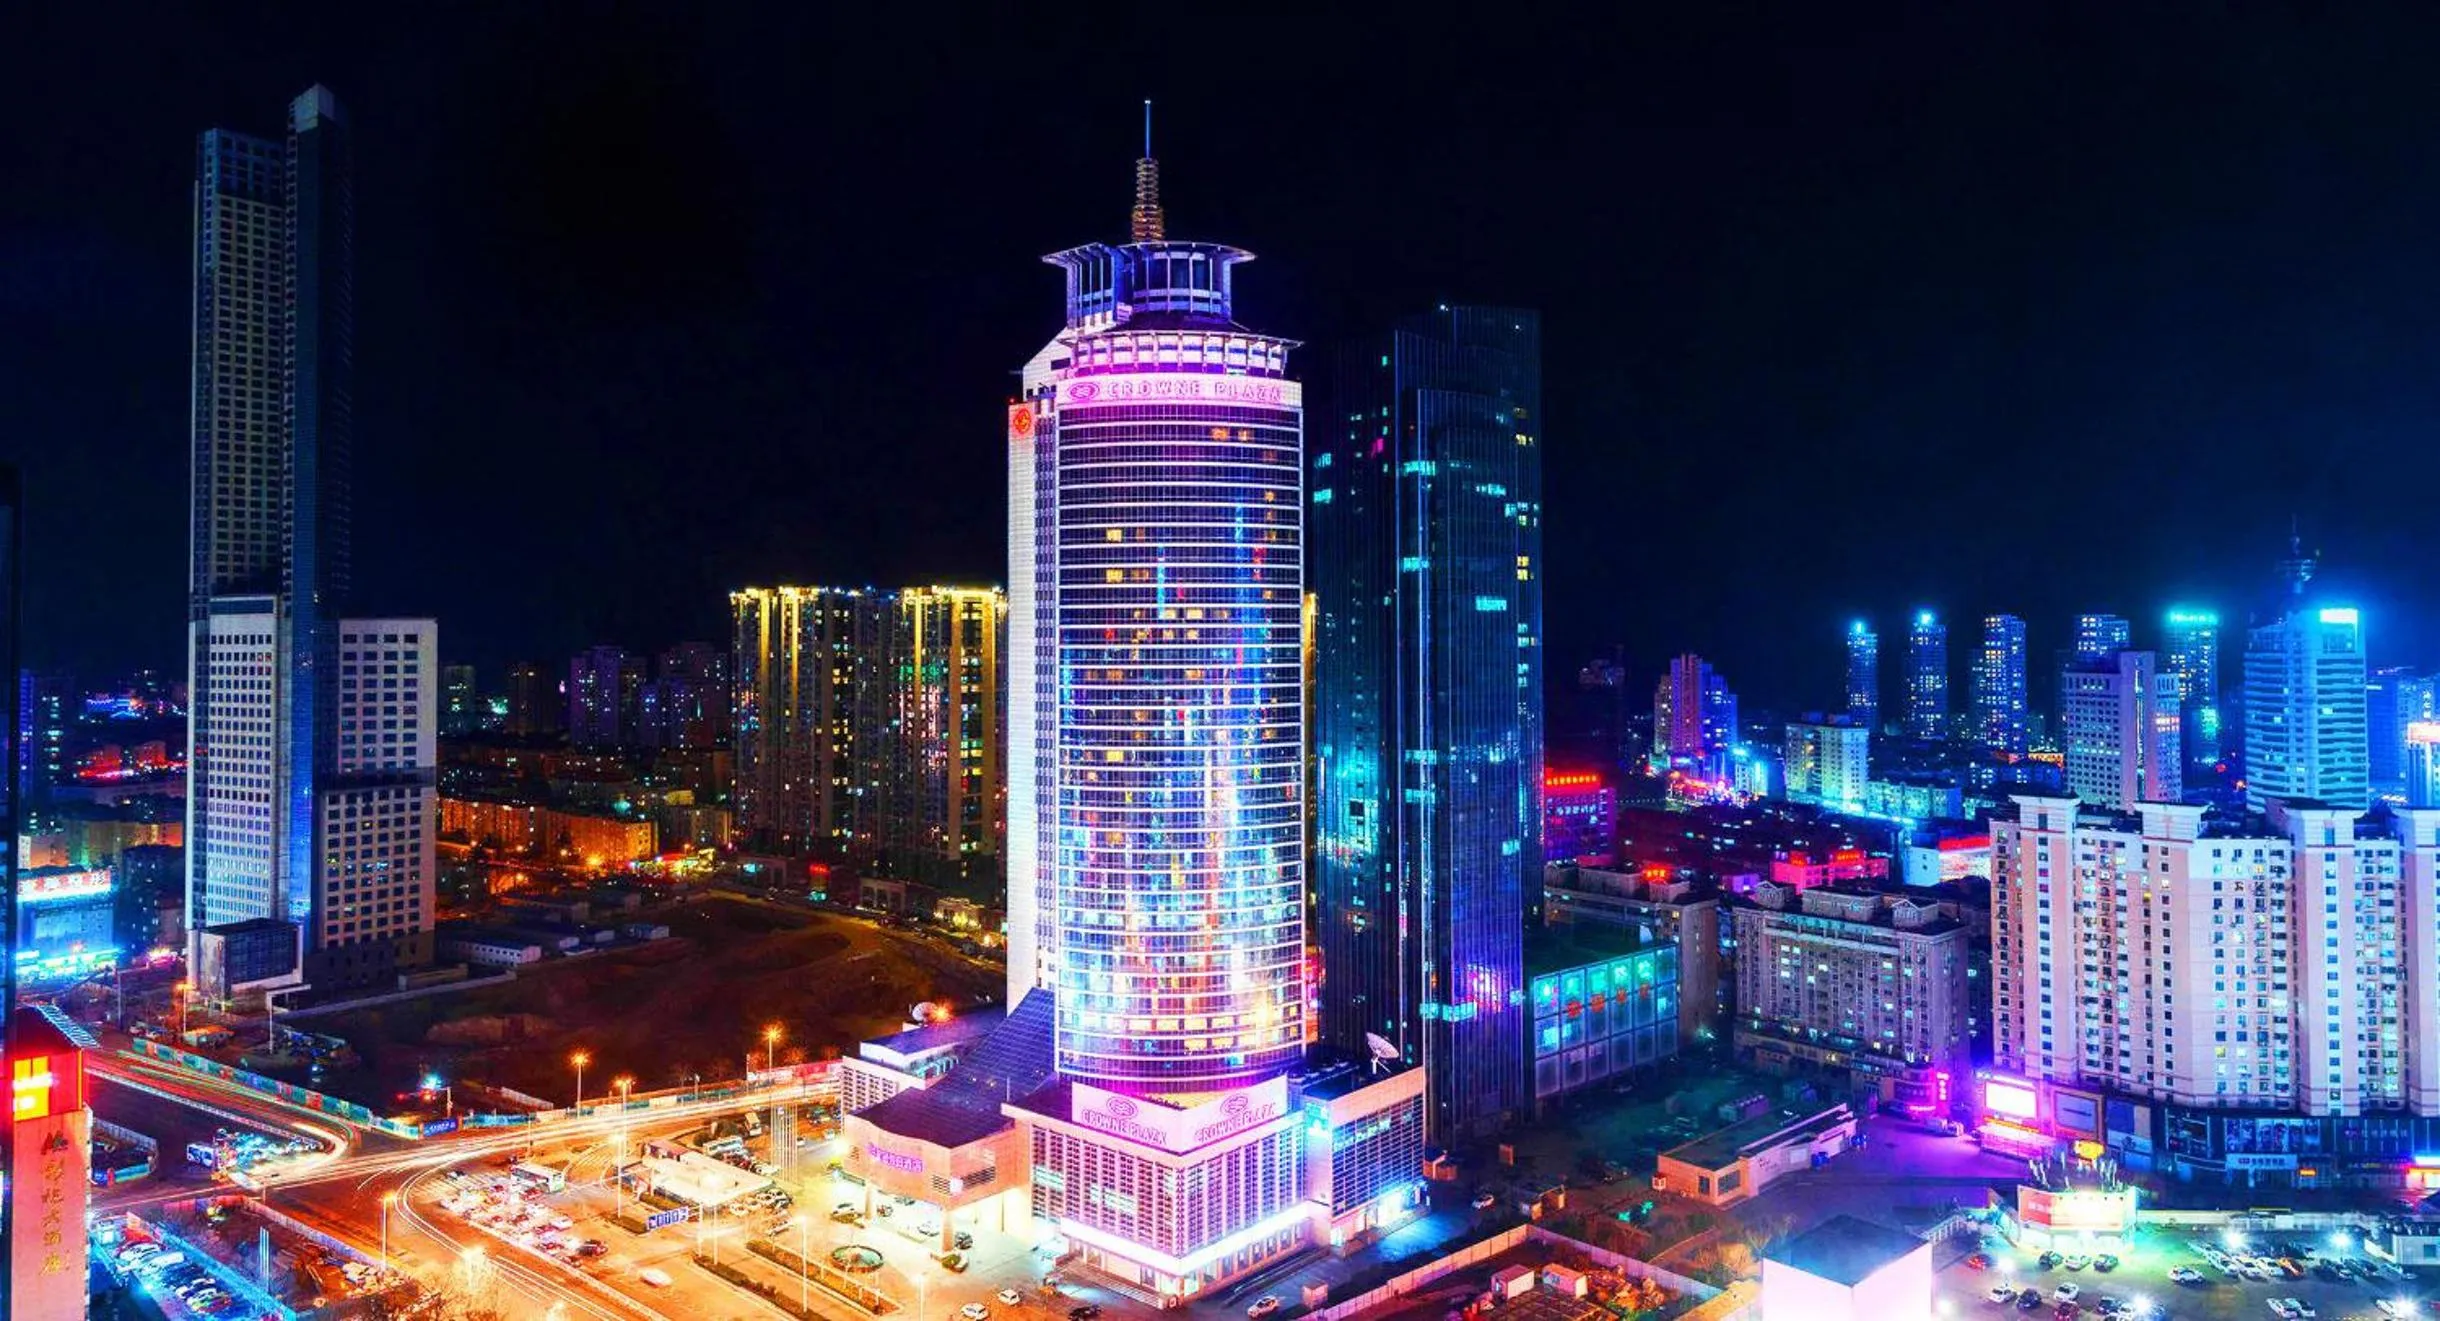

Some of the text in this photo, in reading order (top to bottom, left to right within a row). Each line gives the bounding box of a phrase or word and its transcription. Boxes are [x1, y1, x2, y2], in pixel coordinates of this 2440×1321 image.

[1107, 380, 1283, 400] CROWNE PLAZA
[1082, 1109, 1167, 1145] CROWNE PLAZA
[1194, 1116, 1243, 1142] CROWNE
